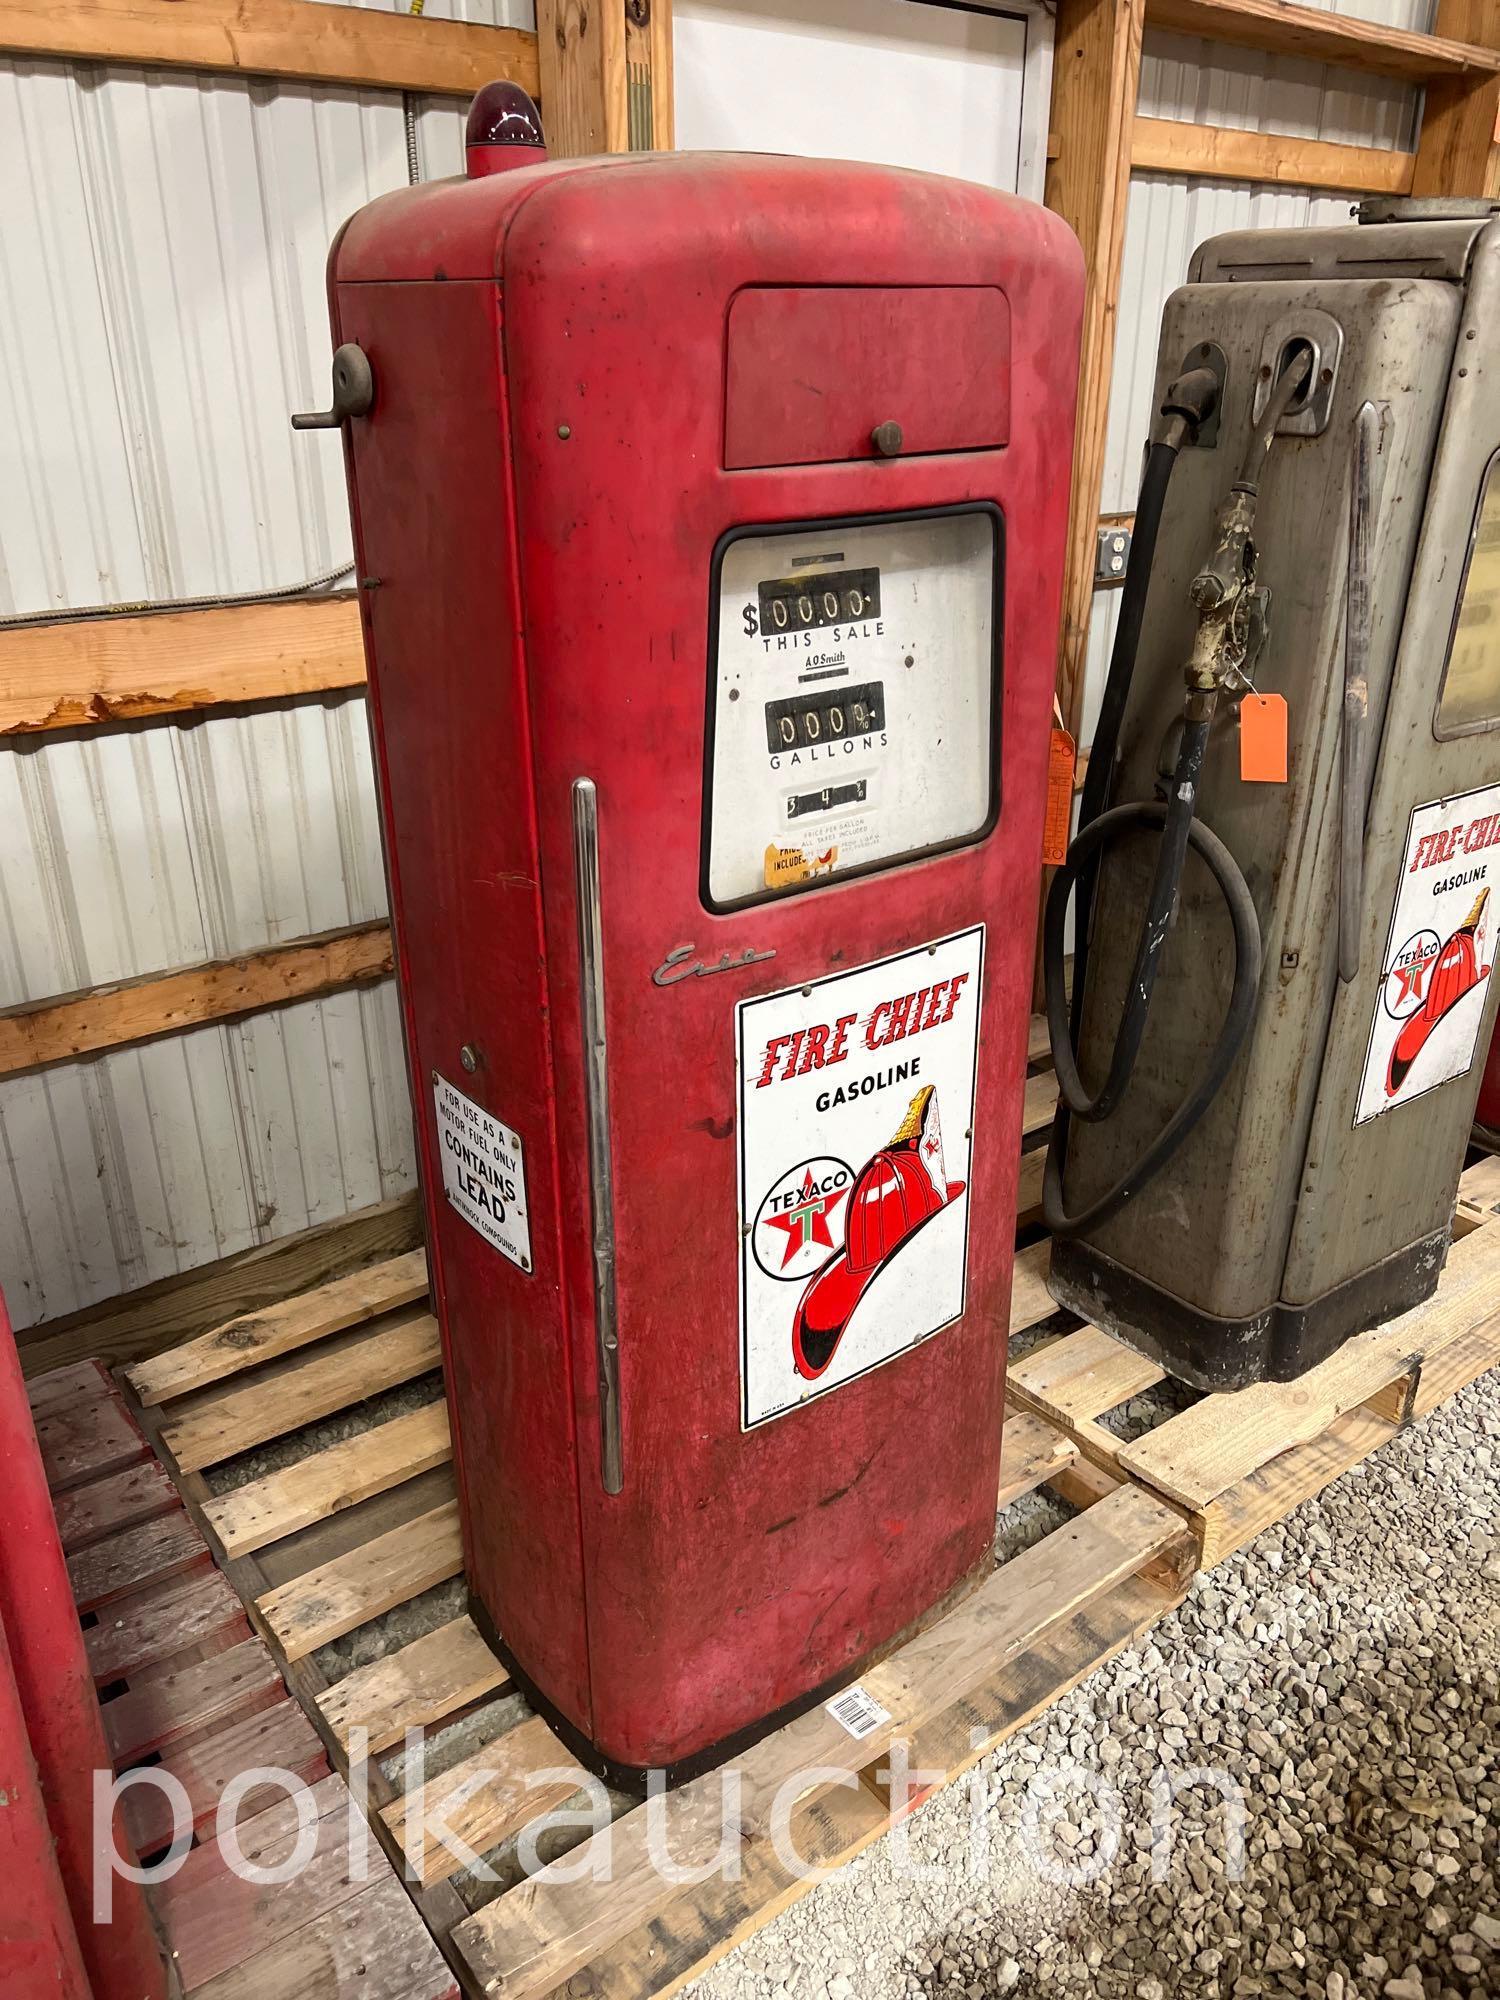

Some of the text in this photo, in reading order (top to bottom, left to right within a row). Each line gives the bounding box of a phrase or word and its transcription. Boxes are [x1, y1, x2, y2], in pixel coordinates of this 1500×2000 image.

[742, 602, 759, 638] $
[763, 622, 885, 652] THIS SALE
[770, 733, 887, 770] GALLONS
[839, 819, 864, 830] GALLON
[773, 854, 807, 871] INCLUDE
[1433, 864, 1488, 896] GASOLINE
[1399, 942, 1438, 967] TEXACO
[755, 972, 969, 1089] FIRE CHIEF
[816, 1057, 921, 1112] GASOLINE
[445, 1088, 505, 1146] FOR USE AS A
[440, 1101, 516, 1173] MOTOR FUEL ONLY
[445, 1129, 516, 1201] CONTAINS
[457, 1164, 506, 1223] LEAD
[770, 1171, 847, 1213] TEXACO
[481, 1220, 518, 1256] COMPOUNDS
